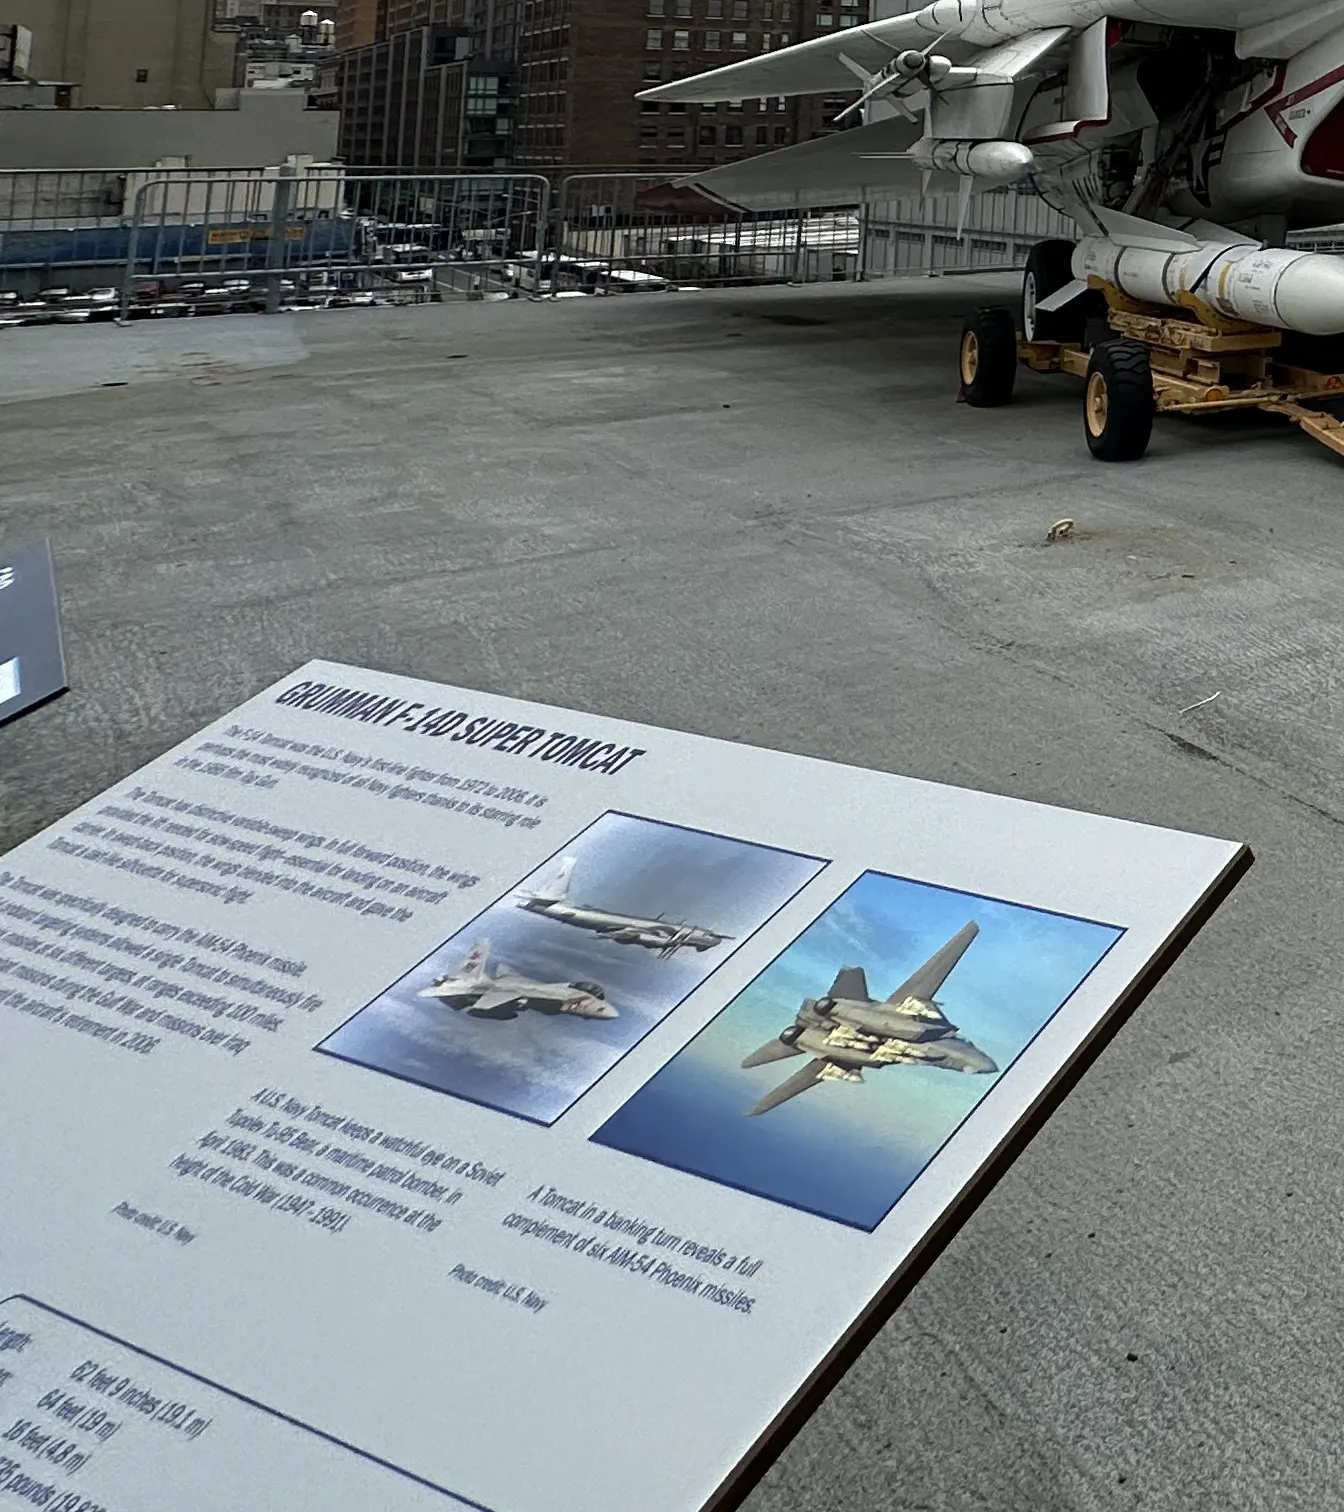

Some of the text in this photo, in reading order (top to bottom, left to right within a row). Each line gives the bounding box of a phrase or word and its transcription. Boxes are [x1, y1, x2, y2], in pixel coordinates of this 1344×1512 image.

[276, 682, 645, 774] GRUMMAN F-14D SUPER TOMCAT
[527, 1185, 763, 1277] A Tomcat in a banking turn reveals a full
[502, 1213, 755, 1313] complement of six AIM-54 Phoenix missiles.
[503, 1284, 527, 1303] U.S.
[69, 1360, 99, 1382] 62
[87, 1368, 119, 1393] feet
[108, 1378, 129, 1397] 9
[118, 1387, 162, 1414] inches
[37, 1389, 122, 1443] 64 feet (19 m)
[150, 1401, 196, 1429] (19.1
[184, 1418, 212, 1440] m)
[0, 1419, 91, 1475] 16 feet (4.8 m)
[0, 1472, 56, 1507] pounds
